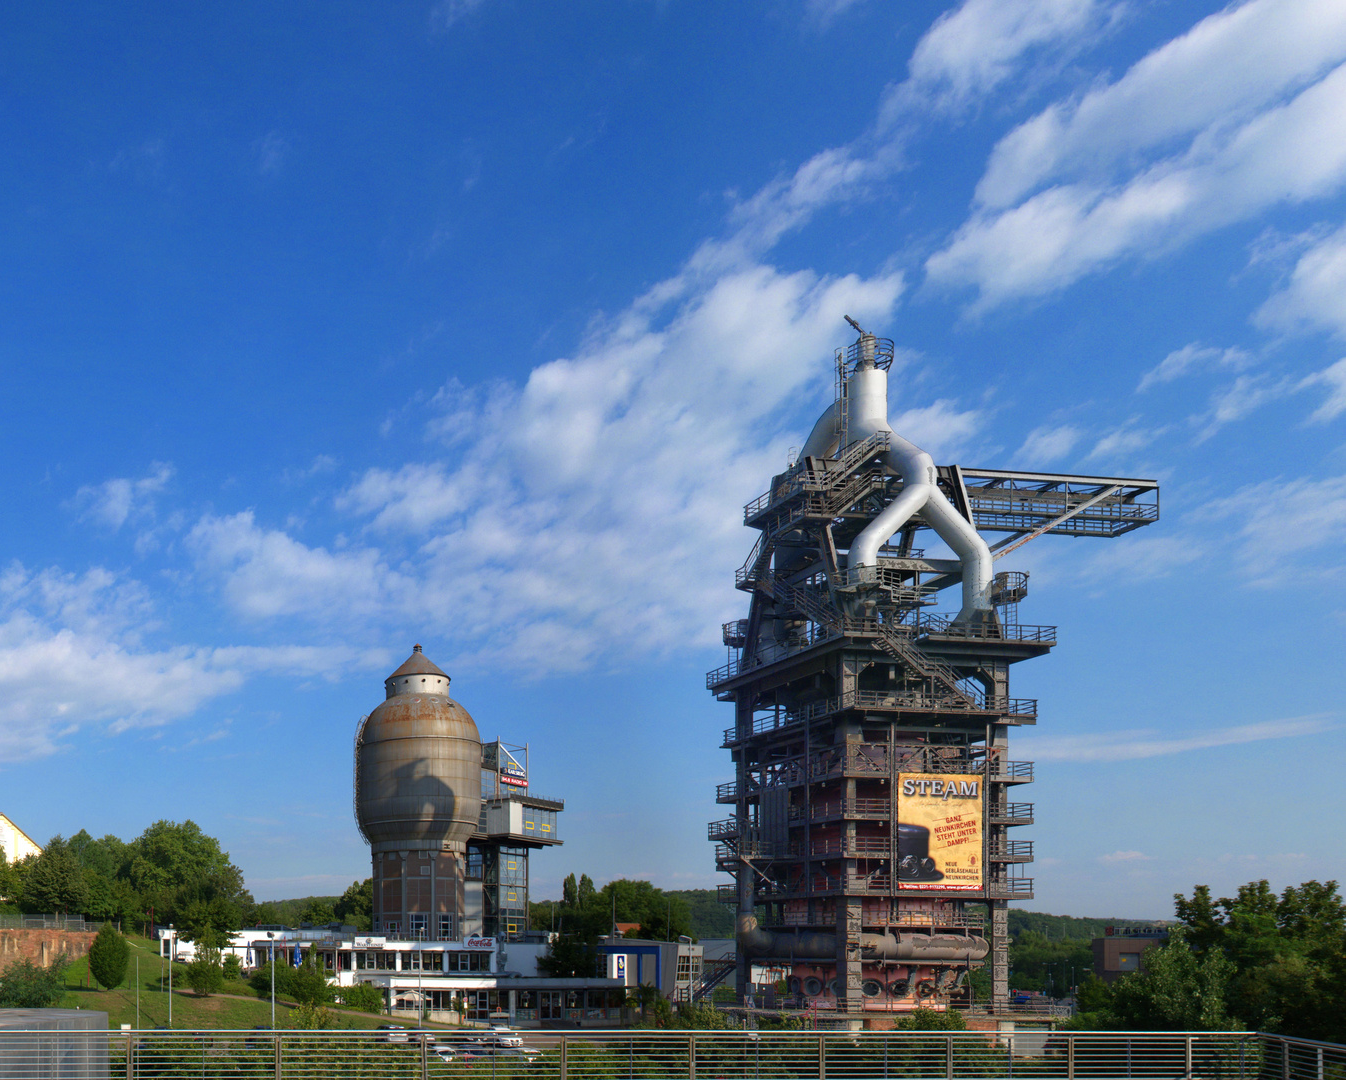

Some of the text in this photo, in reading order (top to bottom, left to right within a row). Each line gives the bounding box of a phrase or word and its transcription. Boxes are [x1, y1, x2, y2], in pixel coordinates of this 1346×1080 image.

[903, 779, 978, 801] STEAM
[945, 815, 962, 823] GANZ
[934, 820, 976, 834] NEUNKIRCHEN
[936, 828, 977, 841] STEHT UNTER
[947, 837, 970, 847] DAMPF!
